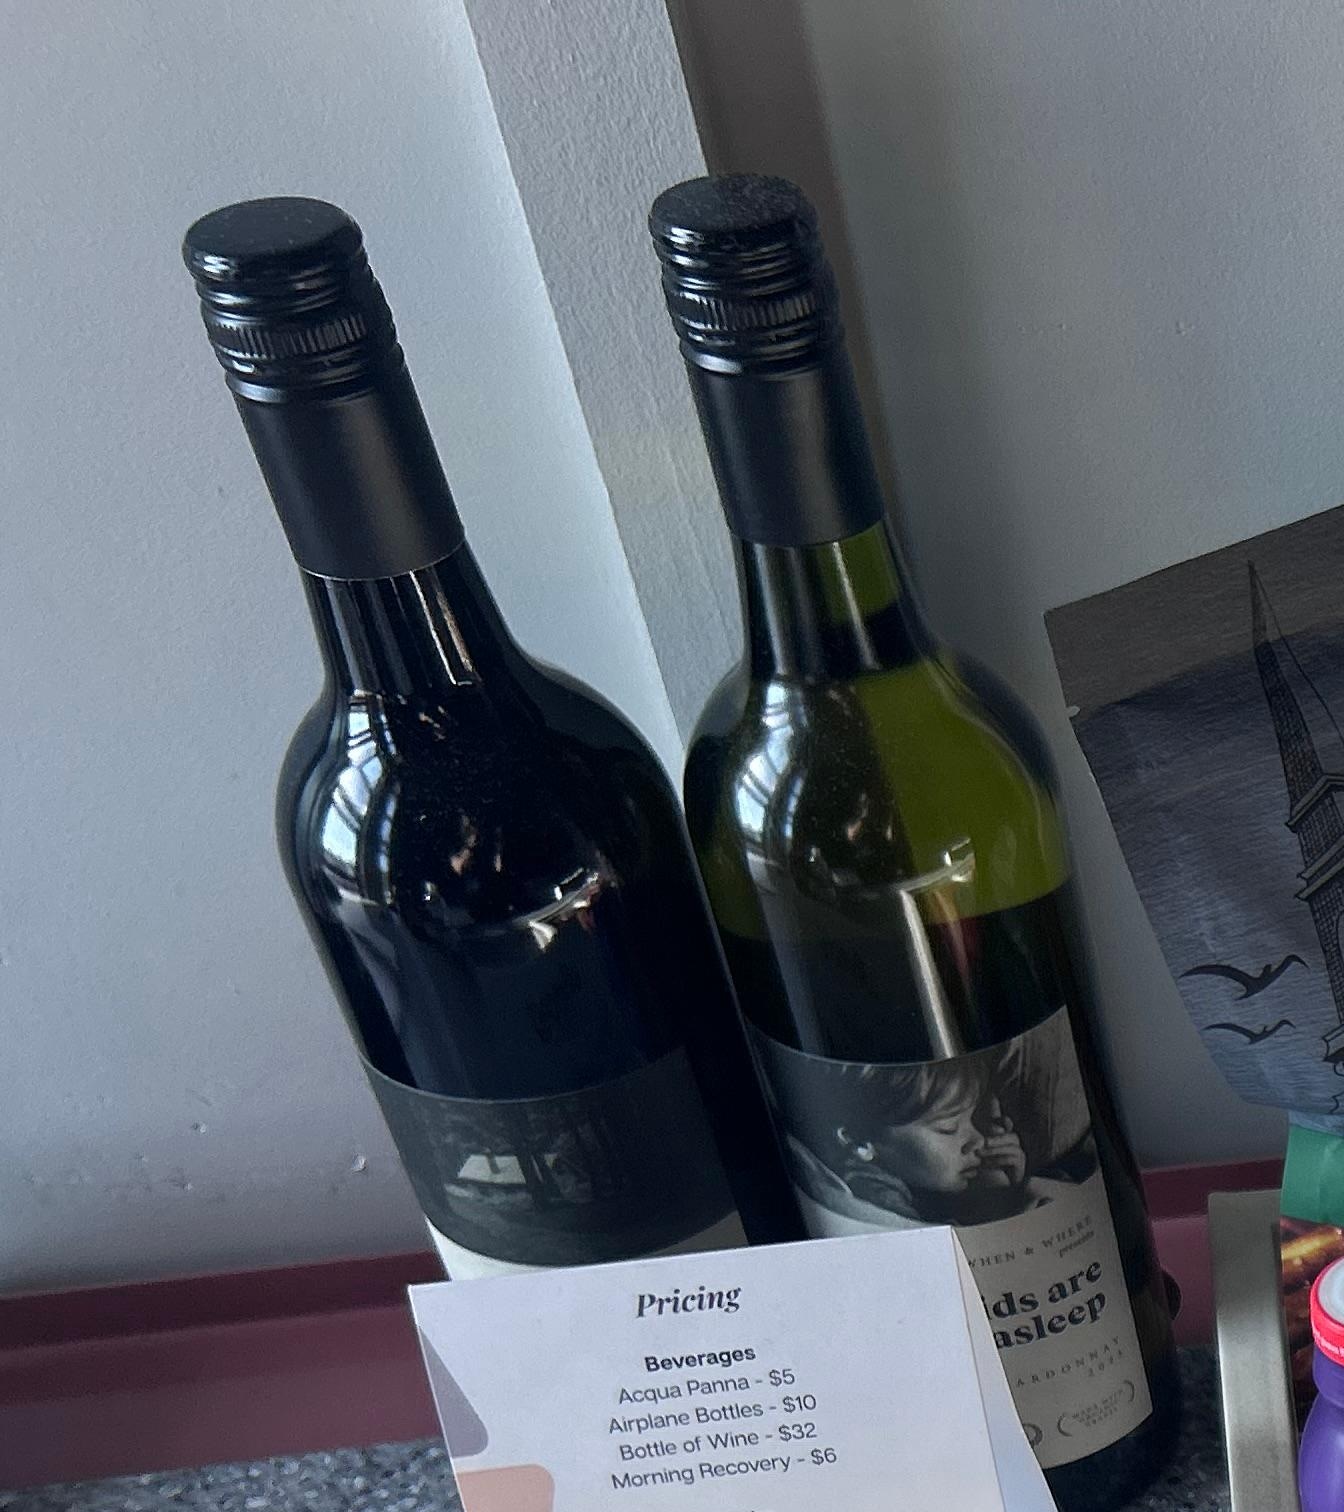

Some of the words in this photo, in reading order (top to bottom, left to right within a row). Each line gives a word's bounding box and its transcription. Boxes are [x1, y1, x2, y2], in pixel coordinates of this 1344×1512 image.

[636, 1285, 741, 1318] Pricing
[1048, 1262, 1102, 1303] are
[993, 1293, 1105, 1349] asleep
[645, 1347, 756, 1372] Beverages
[619, 1384, 682, 1405] Acqua
[687, 1376, 750, 1396] Panna
[769, 1368, 795, 1387] $5
[609, 1411, 690, 1435] Airplane
[695, 1402, 764, 1424] Bottles
[782, 1394, 817, 1413] $10
[619, 1441, 677, 1461] Bottle
[683, 1436, 701, 1453] of
[707, 1430, 760, 1450] Wine
[779, 1422, 817, 1442] $32
[611, 1467, 694, 1490] Morning
[700, 1455, 791, 1479] Recovery
[811, 1447, 837, 1466] $6
